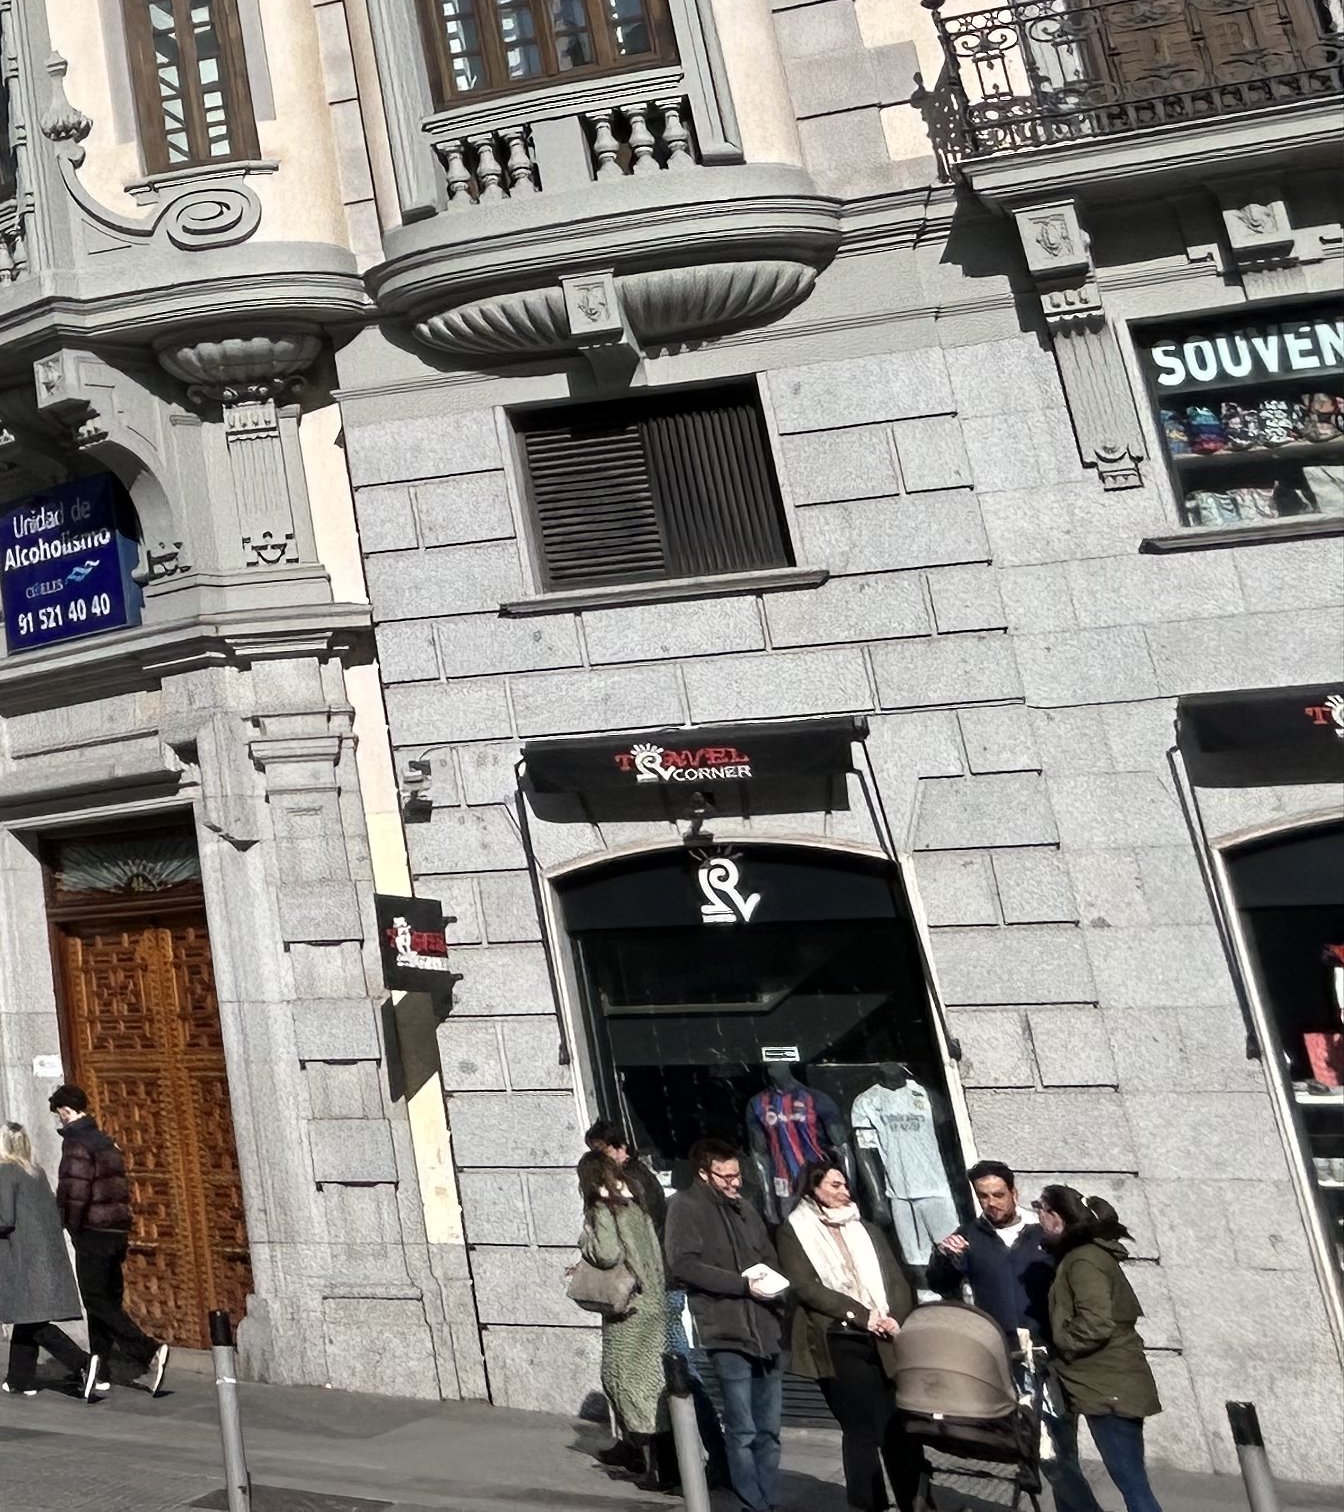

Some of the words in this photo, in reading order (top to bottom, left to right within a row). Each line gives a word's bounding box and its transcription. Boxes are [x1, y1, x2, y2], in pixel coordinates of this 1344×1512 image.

[13, 502, 64, 538] Unidad
[71, 496, 91, 523] de
[4, 527, 111, 571] Alcoholismo
[18, 611, 34, 635] 91
[38, 604, 63, 630] 521
[68, 599, 87, 622] 40
[91, 593, 111, 617] 40
[672, 765, 752, 781] CORNER
